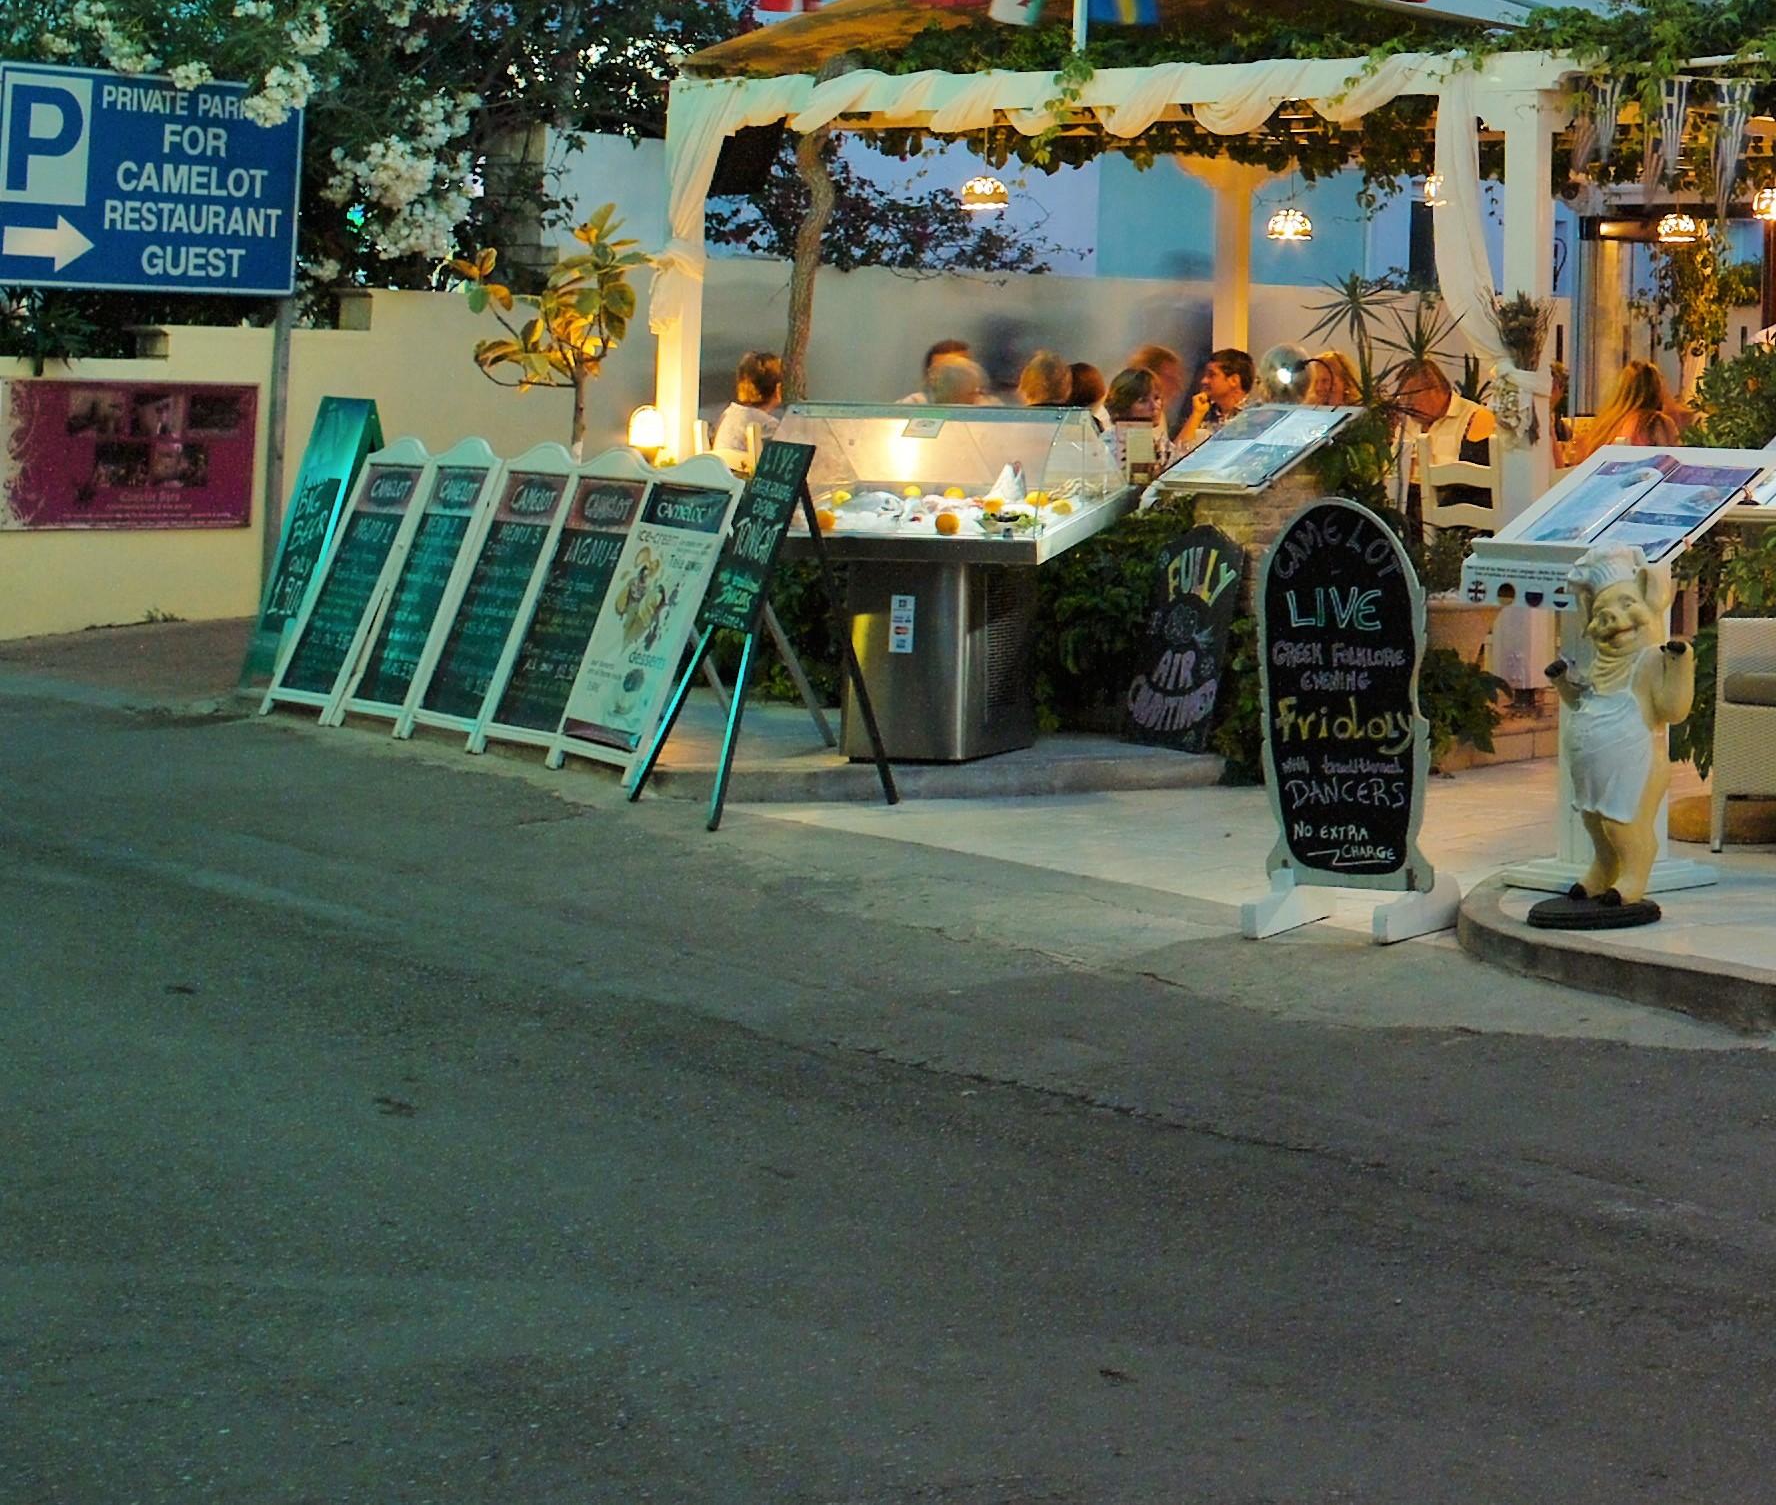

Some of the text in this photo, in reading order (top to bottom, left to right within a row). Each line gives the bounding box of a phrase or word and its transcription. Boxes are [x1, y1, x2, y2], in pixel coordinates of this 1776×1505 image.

[102, 85, 188, 115] PRIVATE
[163, 123, 228, 157] FOR
[117, 161, 268, 198] CAMELOT
[104, 199, 282, 238] RESTAURANT
[141, 245, 246, 278] GUEST
[1273, 513, 1401, 580] CAMELOT
[1168, 546, 1237, 607] FULLY
[1286, 586, 1382, 631] LIVE
[1152, 649, 1196, 690] AIR
[1272, 641, 1322, 668] GREEK
[1284, 779, 1405, 809] DANCERS
[1319, 823, 1368, 842] EXTRA
[1341, 843, 1396, 860] CHARGE
